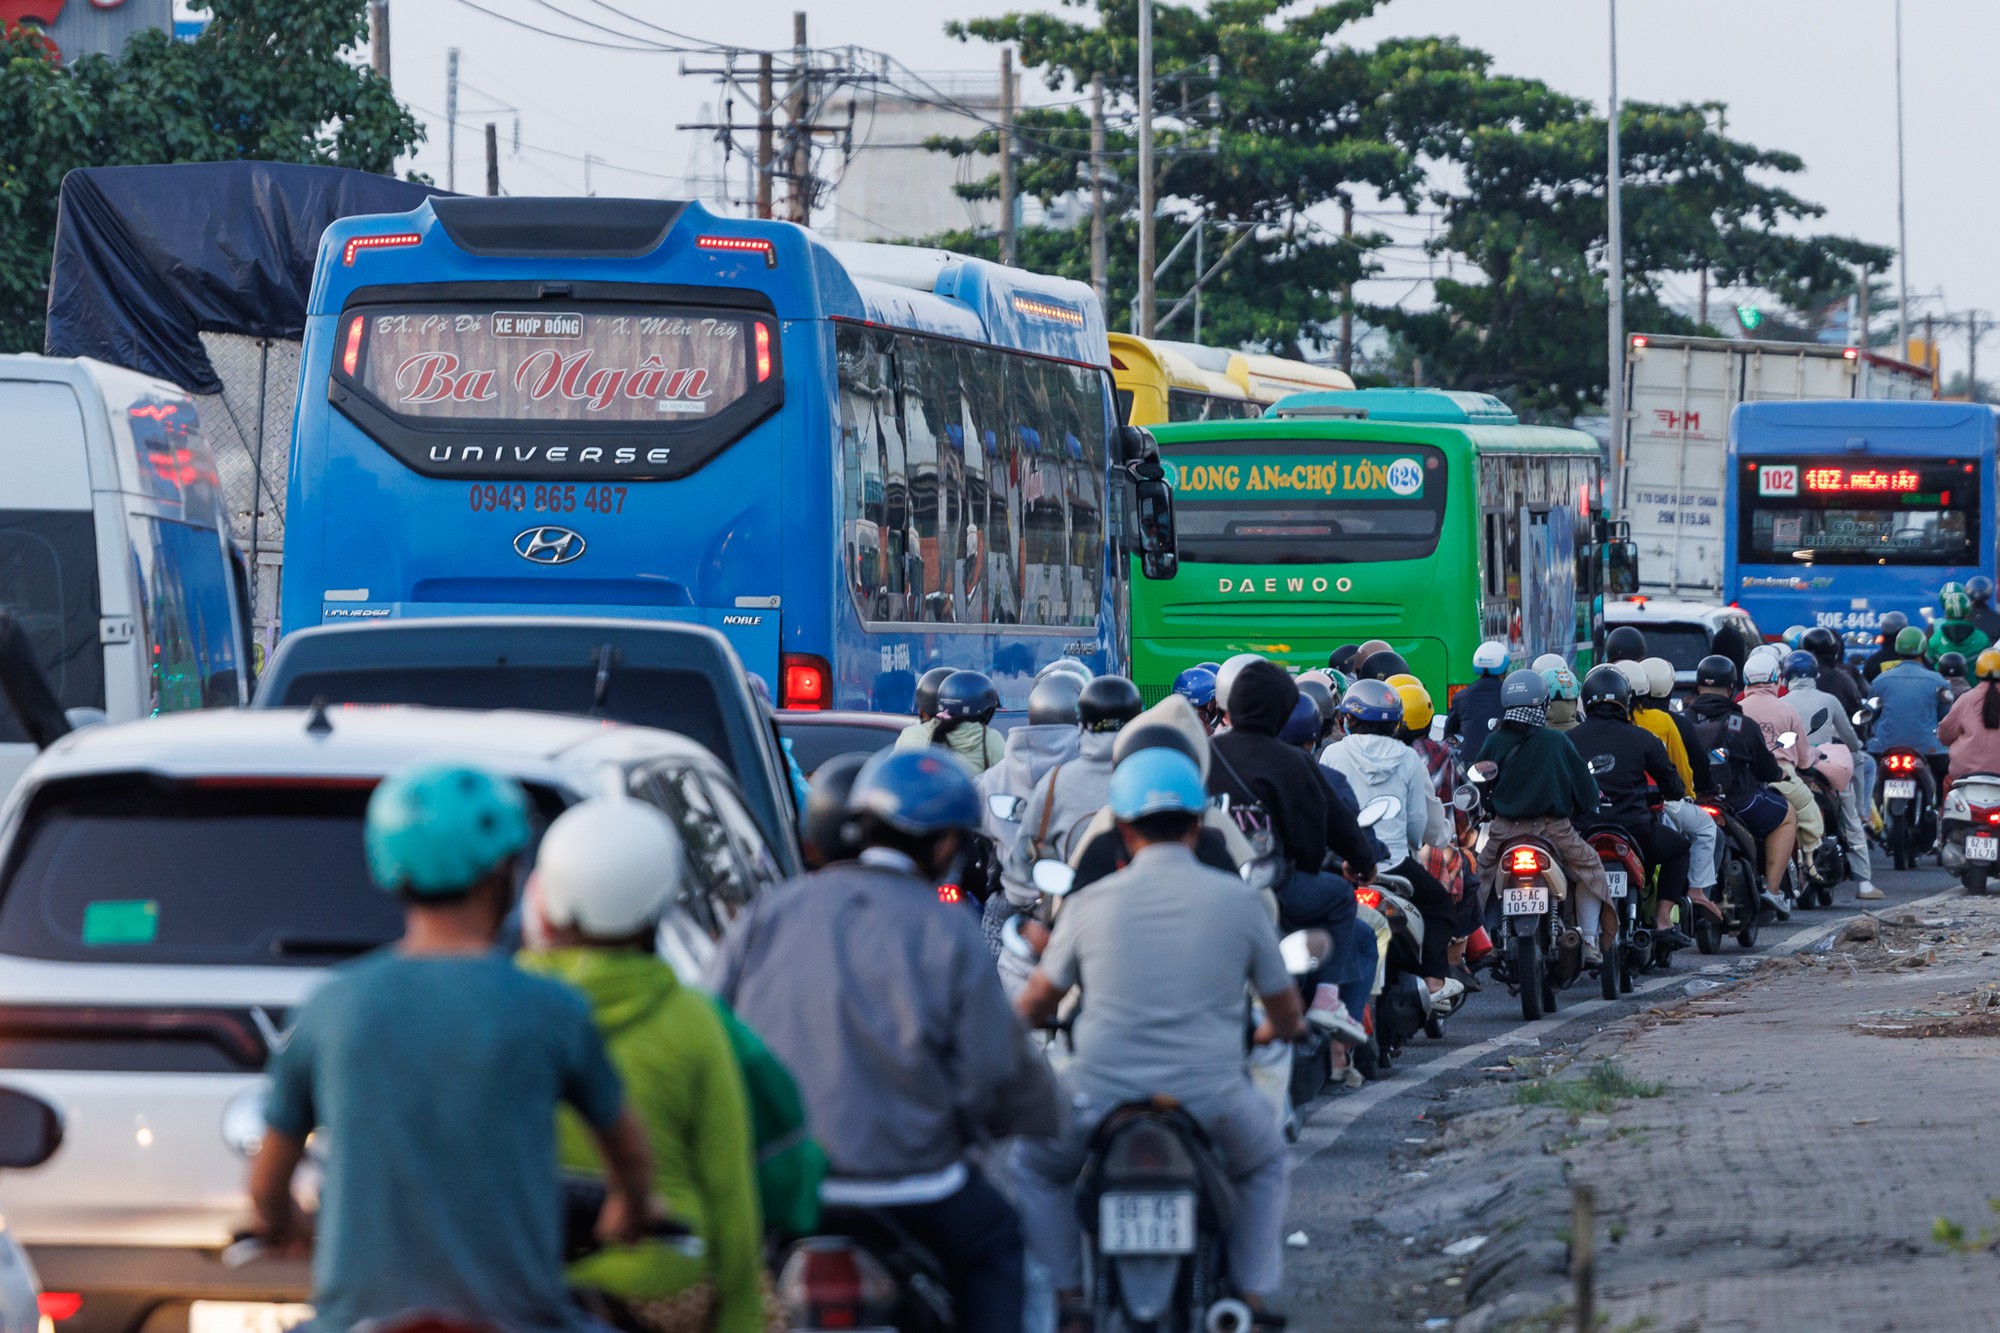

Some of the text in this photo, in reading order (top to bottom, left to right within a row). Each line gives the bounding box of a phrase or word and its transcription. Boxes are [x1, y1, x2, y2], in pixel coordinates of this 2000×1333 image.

[495, 318, 513, 334] XE
[515, 316, 543, 336] HỢP
[700, 318, 738, 340] Tây
[395, 349, 713, 411] Ba Ngân
[429, 445, 671, 464] UNIVERSE
[1179, 457, 1388, 495] LONG AN CHỢ LỚN
[1389, 466, 1421, 487] 628
[1762, 470, 1794, 490] 102
[534, 484, 576, 513] 865
[584, 485, 628, 514] 487
[1218, 578, 1352, 593] DAEWOO
[723, 615, 762, 626] NOBLE
[1510, 889, 1540, 901] 63-AC
[1507, 901, 1545, 913] 105.78
